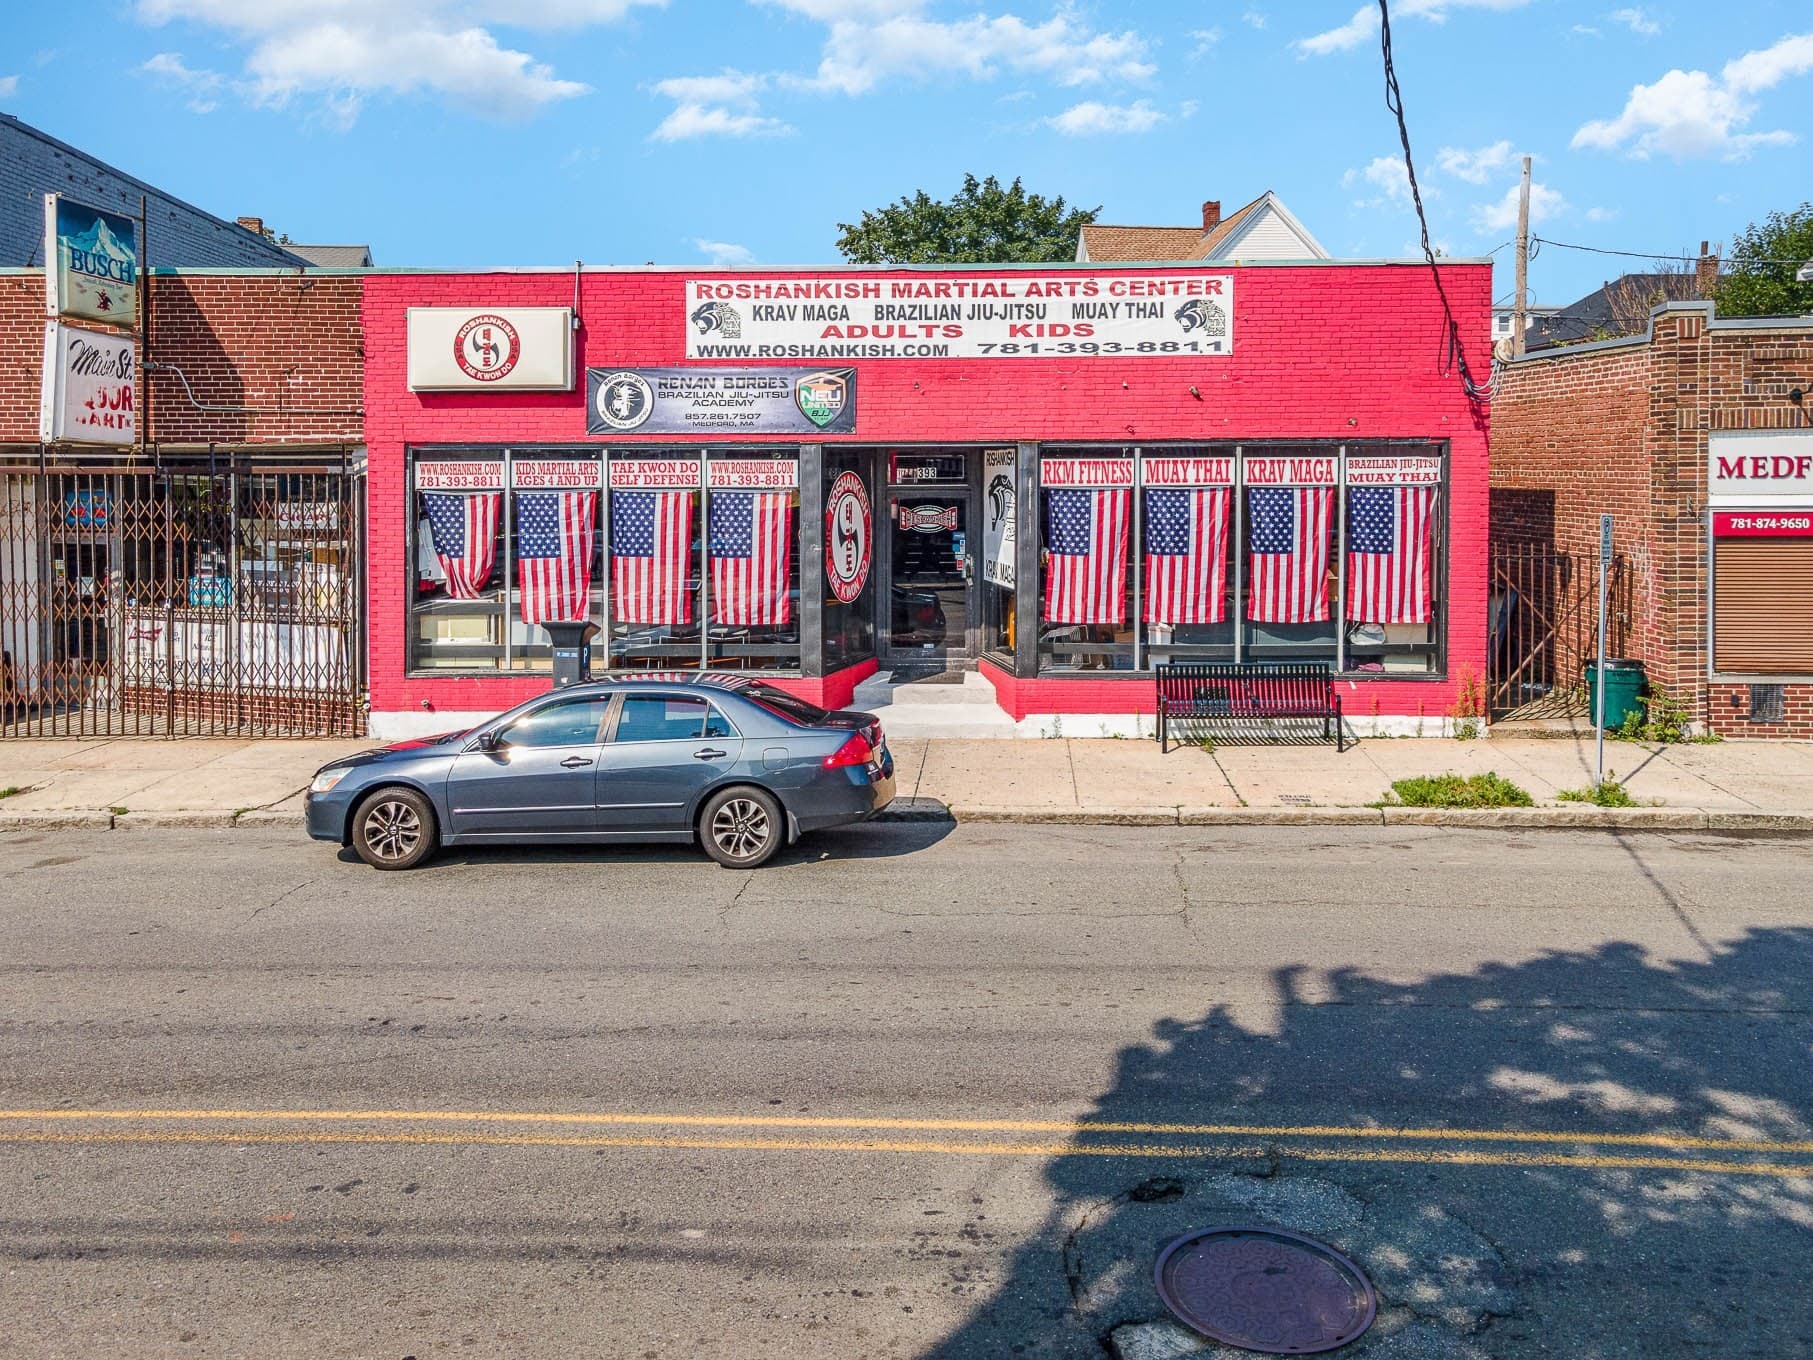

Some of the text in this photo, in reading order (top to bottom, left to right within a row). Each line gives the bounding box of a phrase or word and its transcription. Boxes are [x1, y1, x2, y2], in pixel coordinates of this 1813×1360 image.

[70, 248, 134, 283] BUSCH
[696, 280, 1223, 299] ROSHANKISH MARTIAL ARTS CENTER
[752, 302, 1164, 321] KRAV MAGA BRAZILIAN JIU-JITSU MUAY THAI
[459, 316, 516, 339] ROSHANKISH
[820, 323, 1095, 339] ADULTS KIDS
[697, 344, 949, 357] WWW.ROSHANKISH.COM
[977, 341, 1223, 354] 781-393-8811
[70, 339, 132, 380] Main St.
[463, 362, 512, 380] TAE KWON DO
[658, 377, 789, 389] RENAN BORGES
[658, 391, 789, 399] BRAZILIAN JIU-JITSU
[692, 399, 755, 407] ACADEMY
[811, 409, 831, 417] BJJ
[986, 451, 1015, 466] ROSHANKISH
[1348, 458, 1439, 470] BRAZILIAN JIU-JITSU
[419, 463, 501, 476] WWW.ROSHANKISH.COM
[516, 462, 599, 475] KIDS MARTIAL ARTS
[612, 462, 699, 474] TAE KWON DO
[711, 462, 794, 474] WWW.ROSHANKISH.COM
[918, 467, 936, 478] 393
[1043, 460, 1132, 484] RKM FITNESS
[1145, 459, 1231, 483] MUAY THAI
[1247, 459, 1334, 483] KRAV MAGA
[1716, 456, 1812, 479] MEDF
[420, 476, 501, 487] 781-393-8811
[516, 475, 599, 486] AGES 4 AND UP
[612, 474, 699, 485] SELF DEFENSE
[711, 475, 794, 486] 781-393-8811
[1348, 472, 1439, 482] MUAY THAI
[829, 475, 869, 515] ROSHANKISH
[1730, 518, 1810, 529] 781-874-9650
[831, 559, 868, 600] TAE KWON DO
[1000, 562, 1014, 584] MAGA
